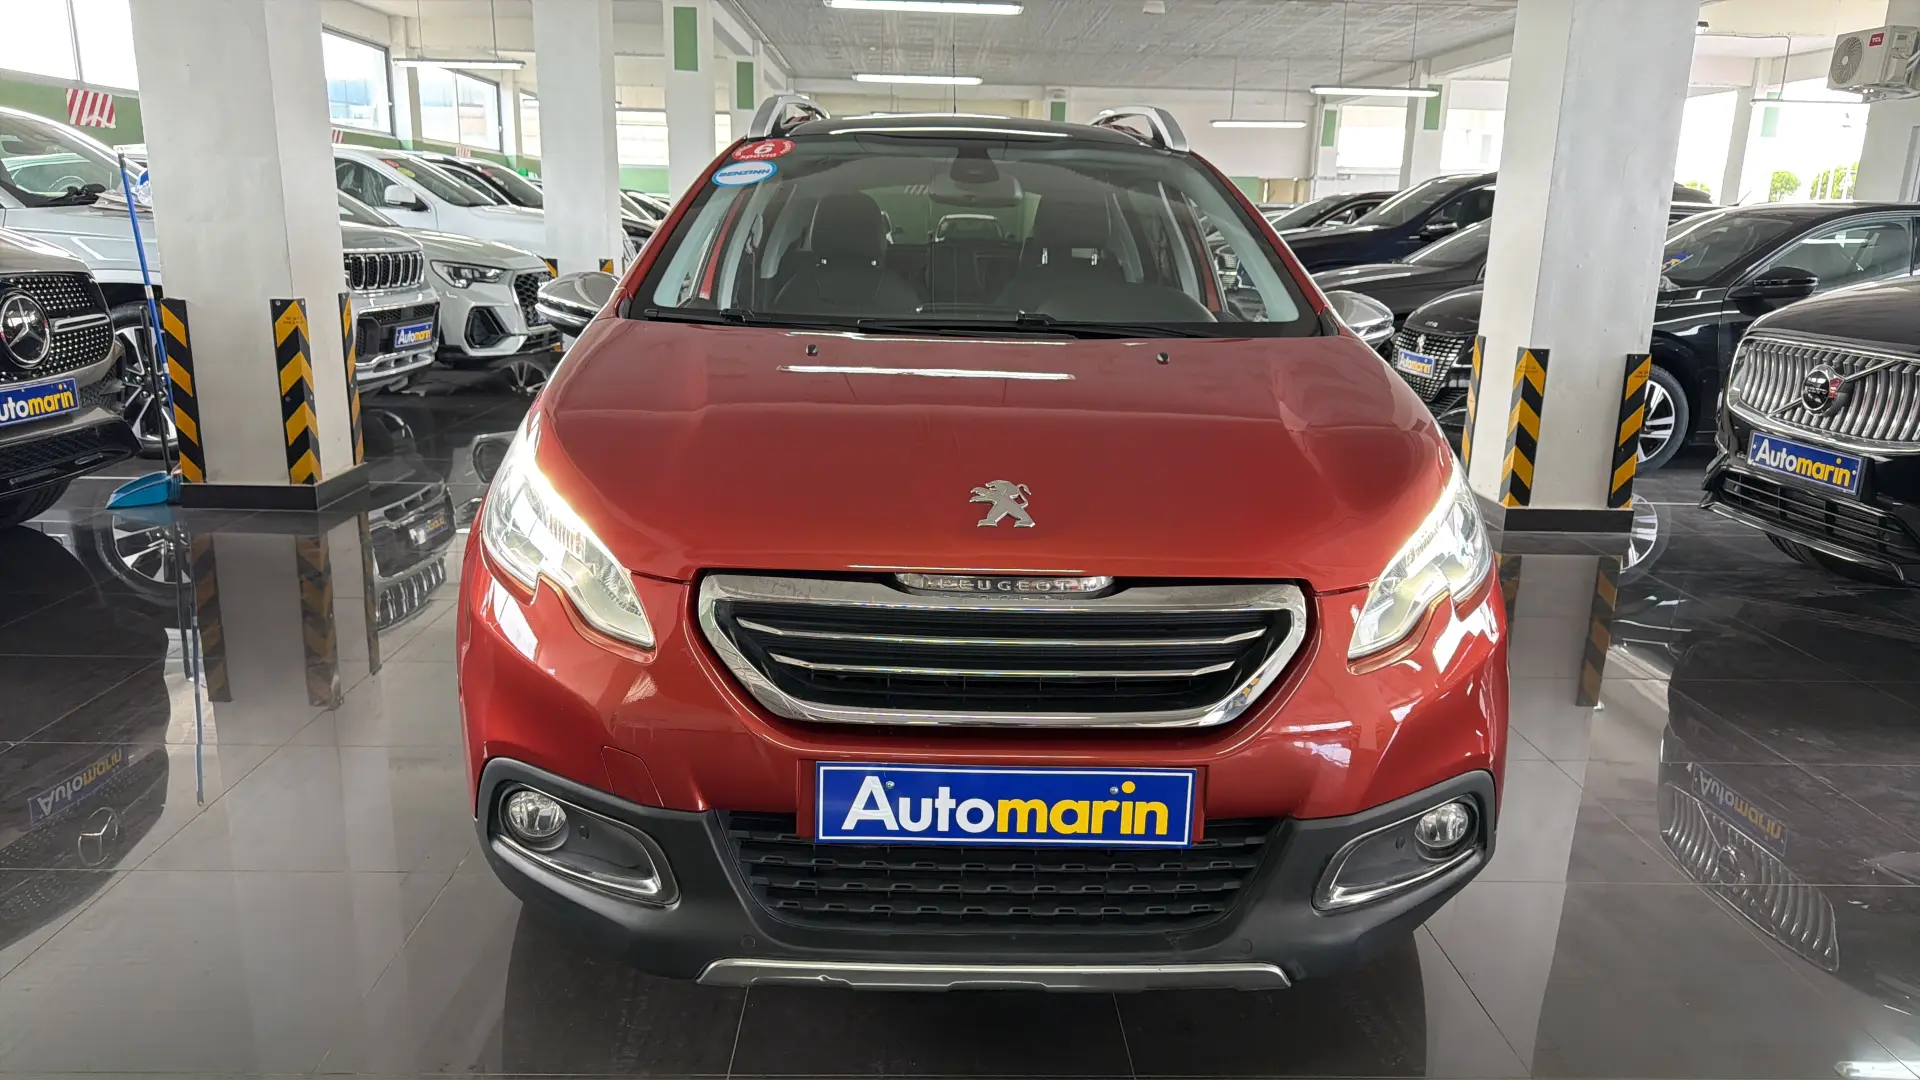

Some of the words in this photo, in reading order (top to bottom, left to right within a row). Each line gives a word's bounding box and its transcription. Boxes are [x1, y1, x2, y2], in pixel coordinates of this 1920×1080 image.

[754, 142, 775, 154] 6
[0, 383, 75, 421] utomarin
[1755, 438, 1851, 487] Automarin
[939, 579, 1071, 592] PEUGEOT
[841, 775, 1169, 836] Automarin
